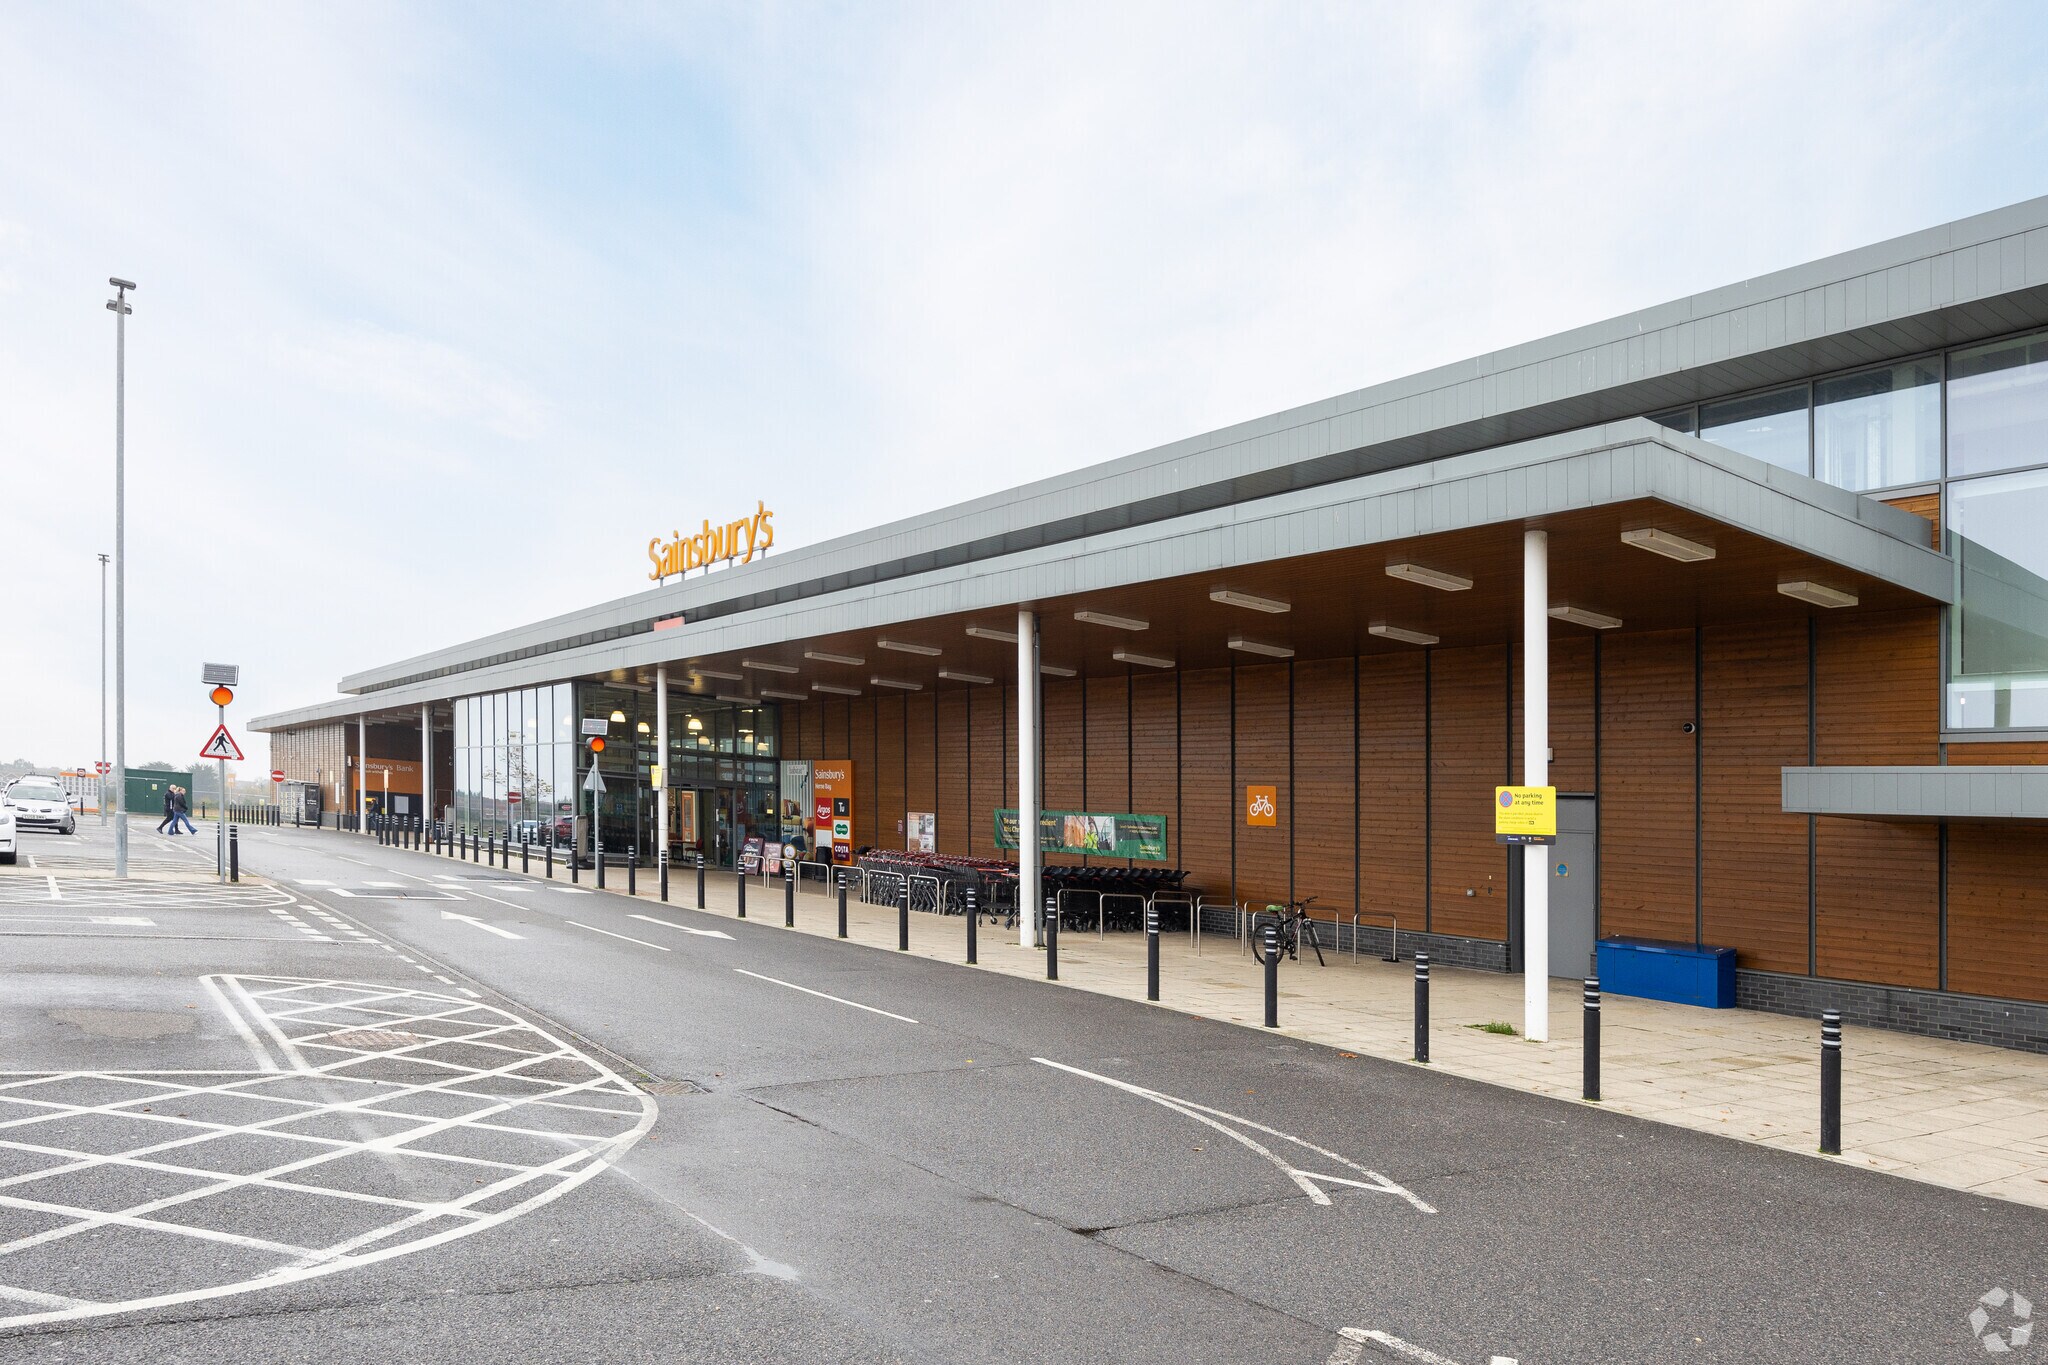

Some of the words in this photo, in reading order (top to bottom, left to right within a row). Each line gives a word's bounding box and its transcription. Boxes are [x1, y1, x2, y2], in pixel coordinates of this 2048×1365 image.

[648, 499, 774, 581] Sainsbury's
[355, 762, 393, 770] Snsbury's
[396, 764, 414, 772] Bank
[815, 769, 844, 781] Sainsbury's
[817, 805, 831, 815] Argos
[835, 845, 849, 853] COSTA
